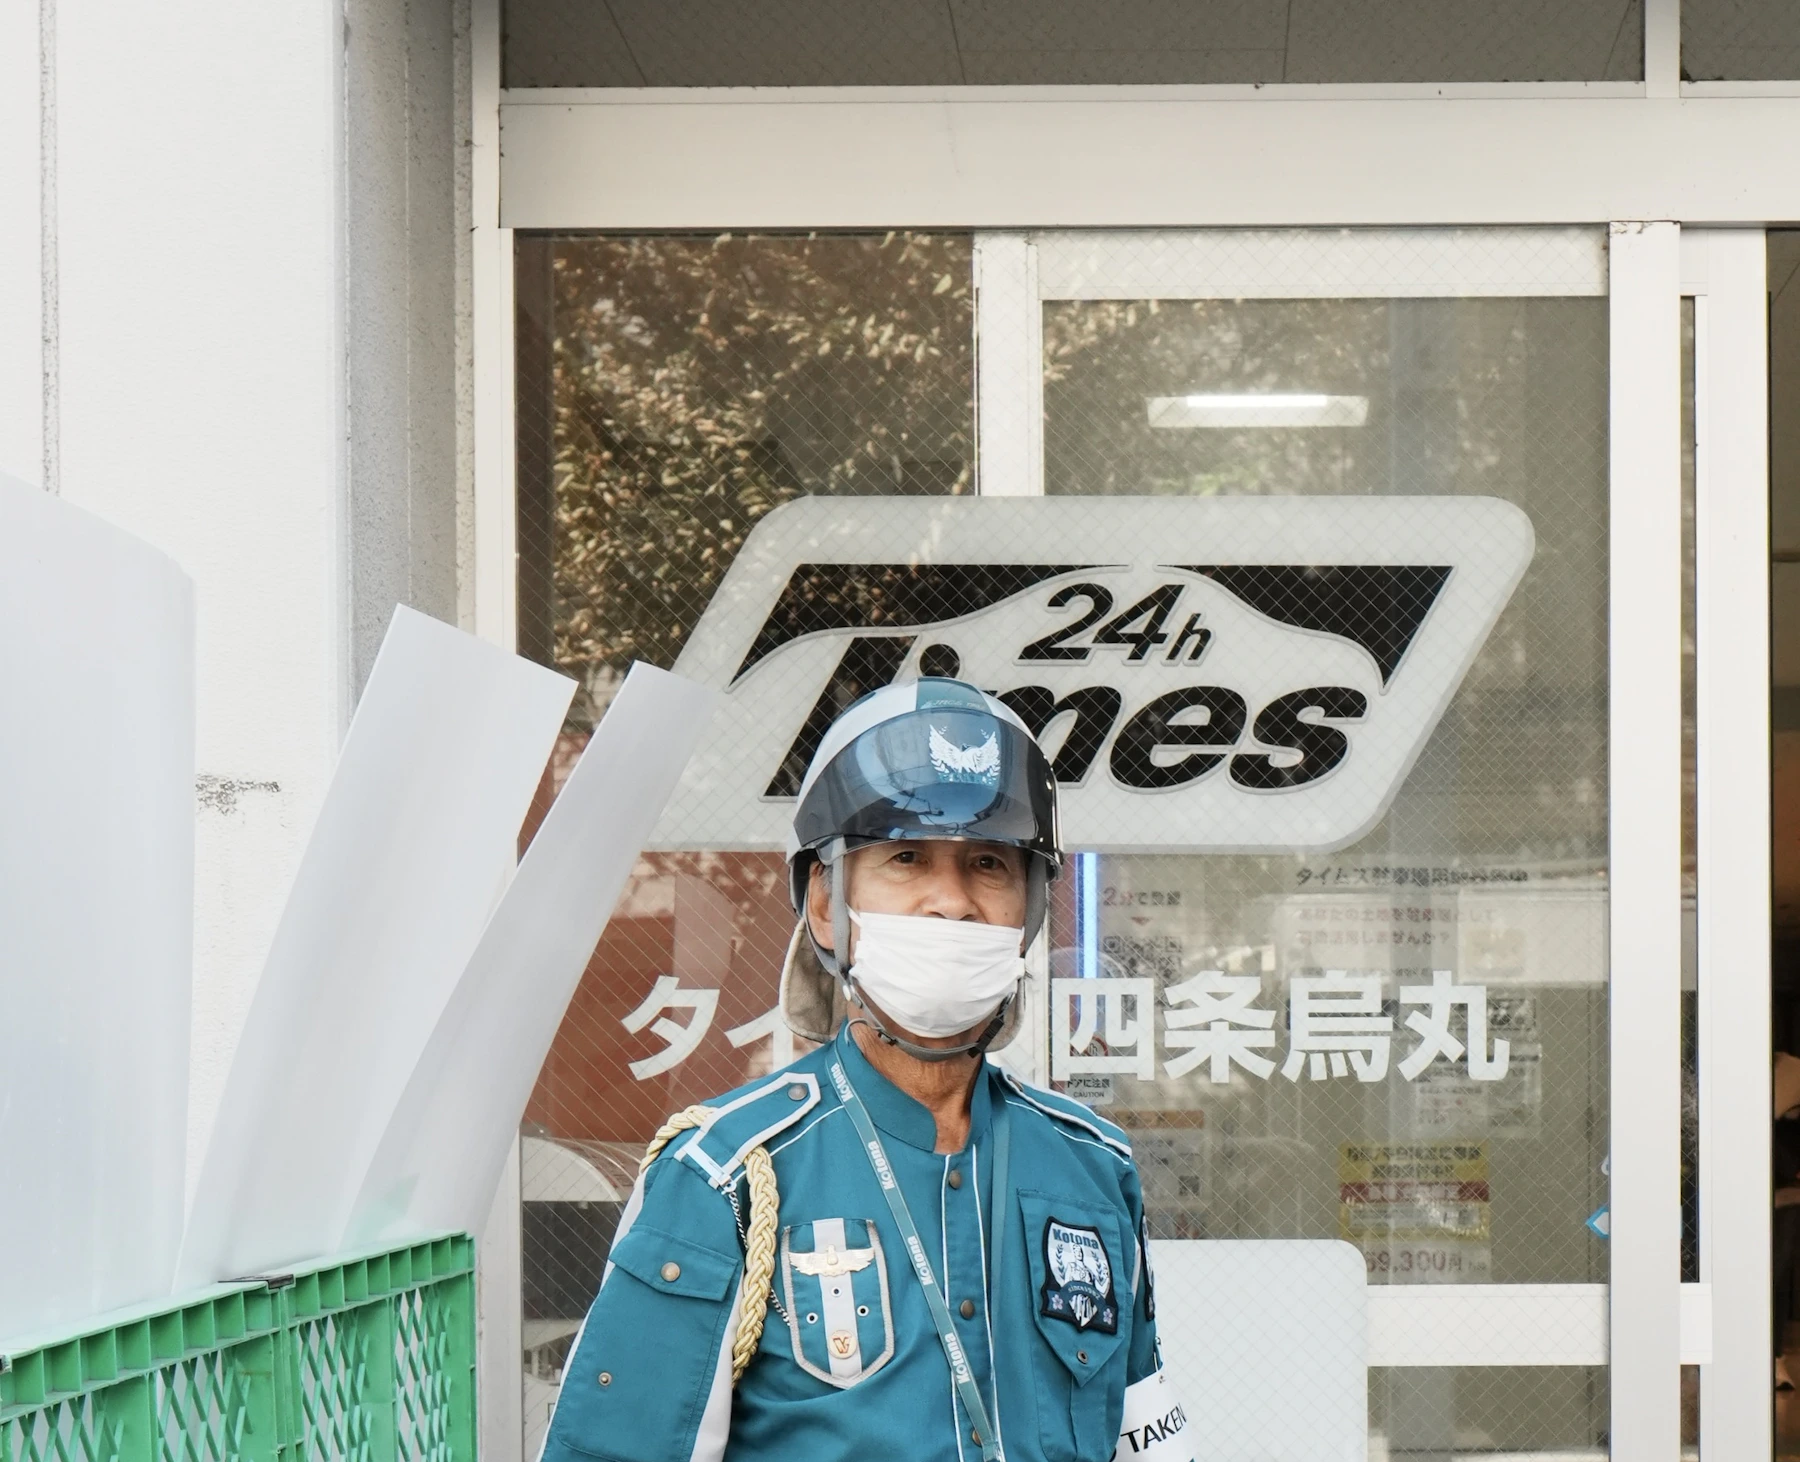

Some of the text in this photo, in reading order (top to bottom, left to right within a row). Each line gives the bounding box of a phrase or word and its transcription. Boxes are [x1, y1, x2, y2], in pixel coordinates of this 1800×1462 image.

[1018, 583, 1212, 661] 24h
[867, 1140, 896, 1190] Kotona
[907, 1235, 934, 1286] Kotona
[1052, 1227, 1100, 1250] Kotona
[944, 1332, 971, 1384] Kotona
